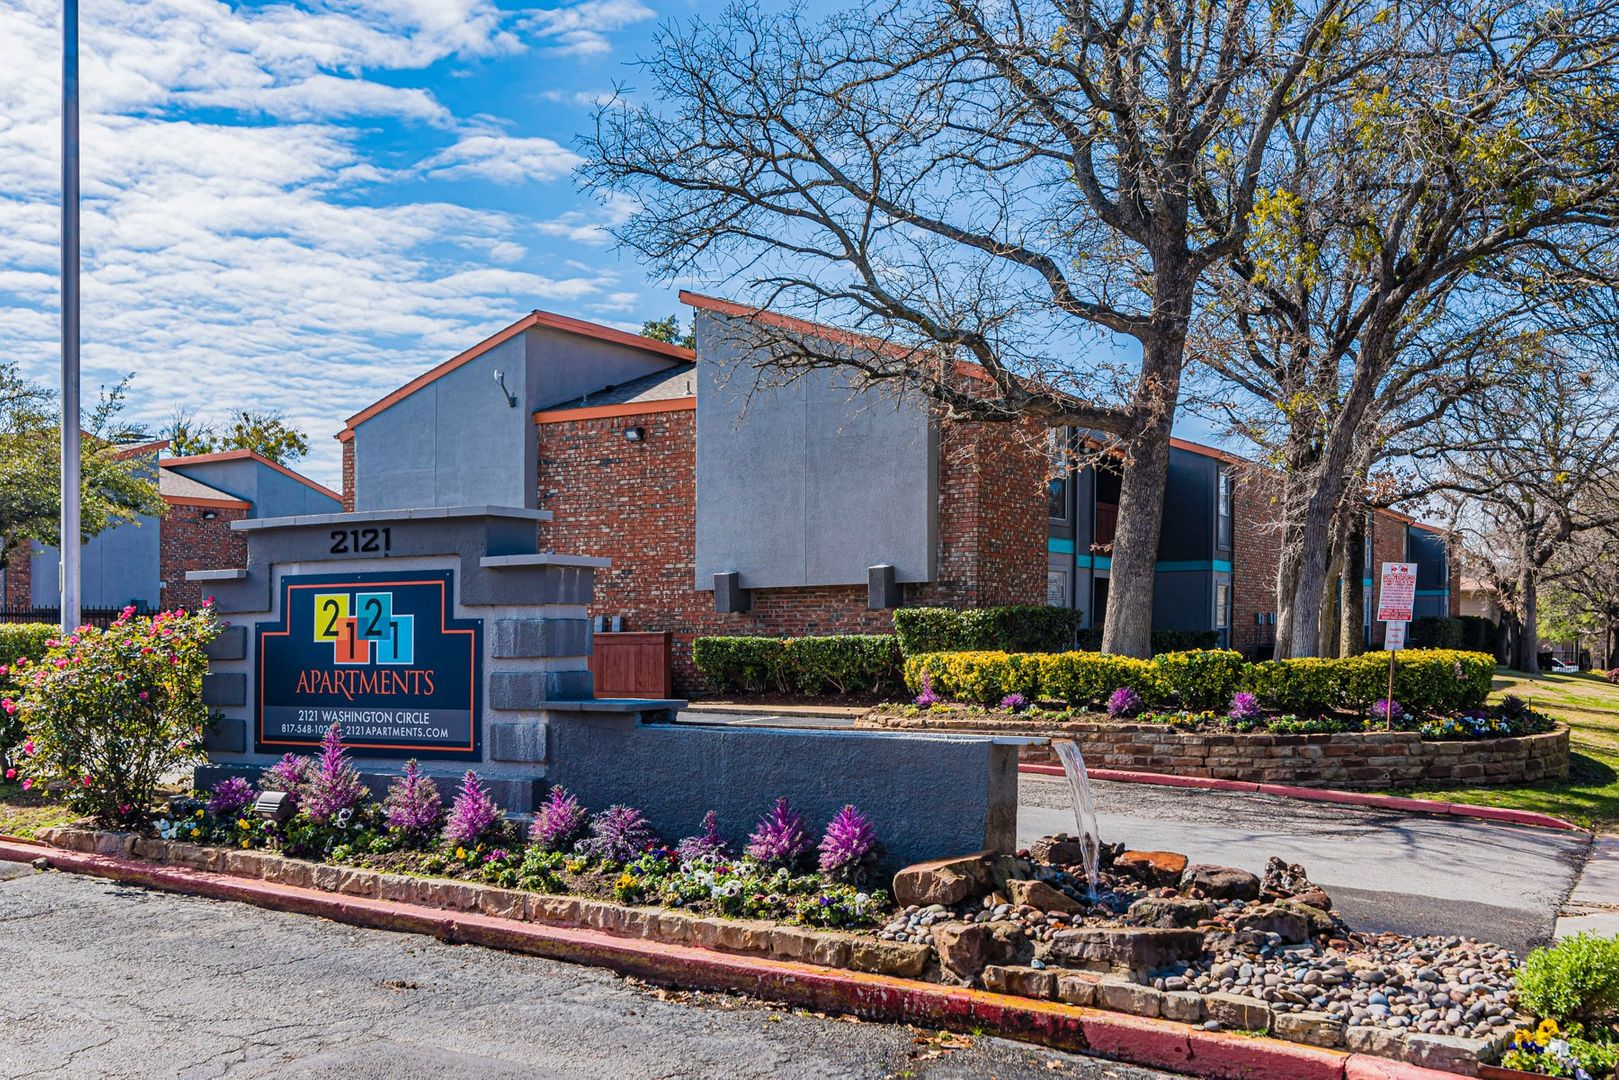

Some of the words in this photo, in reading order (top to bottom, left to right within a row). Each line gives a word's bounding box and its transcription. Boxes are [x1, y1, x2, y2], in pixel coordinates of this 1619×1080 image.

[330, 527, 391, 554] 2121
[322, 597, 399, 660] 2121
[296, 669, 435, 701] APARTMENTS
[281, 724, 333, 734] 817-548-102
[346, 725, 448, 738] 2121APARTMENTS.COM
[298, 710, 318, 722] 2121
[321, 711, 393, 724] WASHINGTON
[395, 712, 430, 725] CIRCLE
